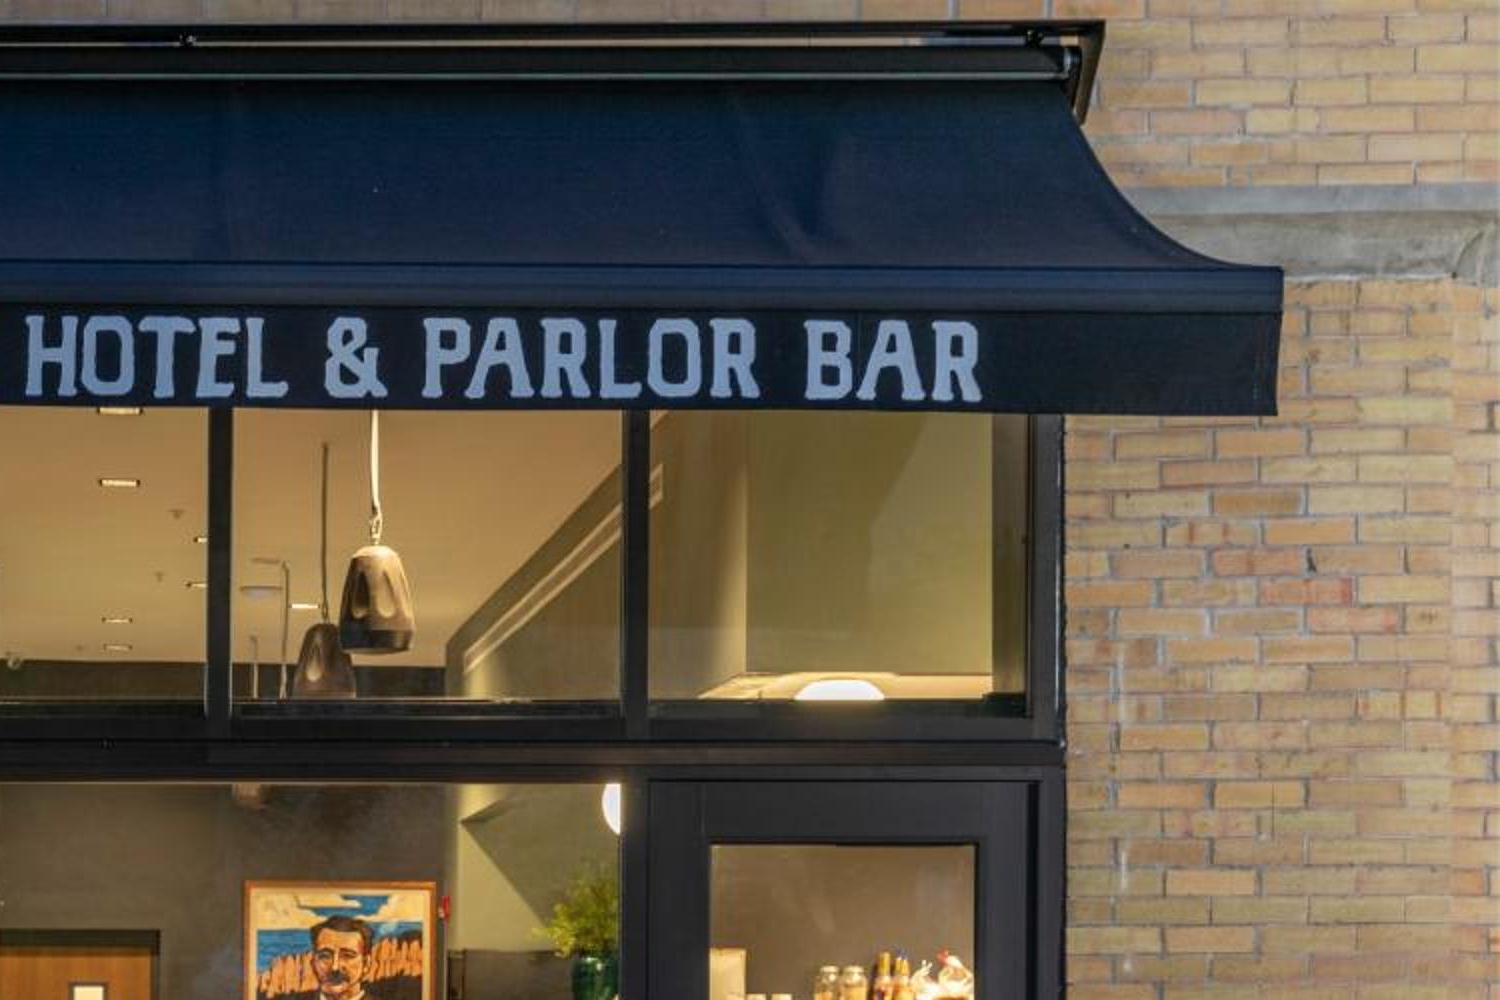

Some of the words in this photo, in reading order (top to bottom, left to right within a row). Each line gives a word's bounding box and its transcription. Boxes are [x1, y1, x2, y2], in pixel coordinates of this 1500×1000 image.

[25, 315, 289, 398] HOTEL
[323, 316, 389, 399] &
[421, 317, 760, 399] PARLOR
[803, 319, 983, 403] BAR
